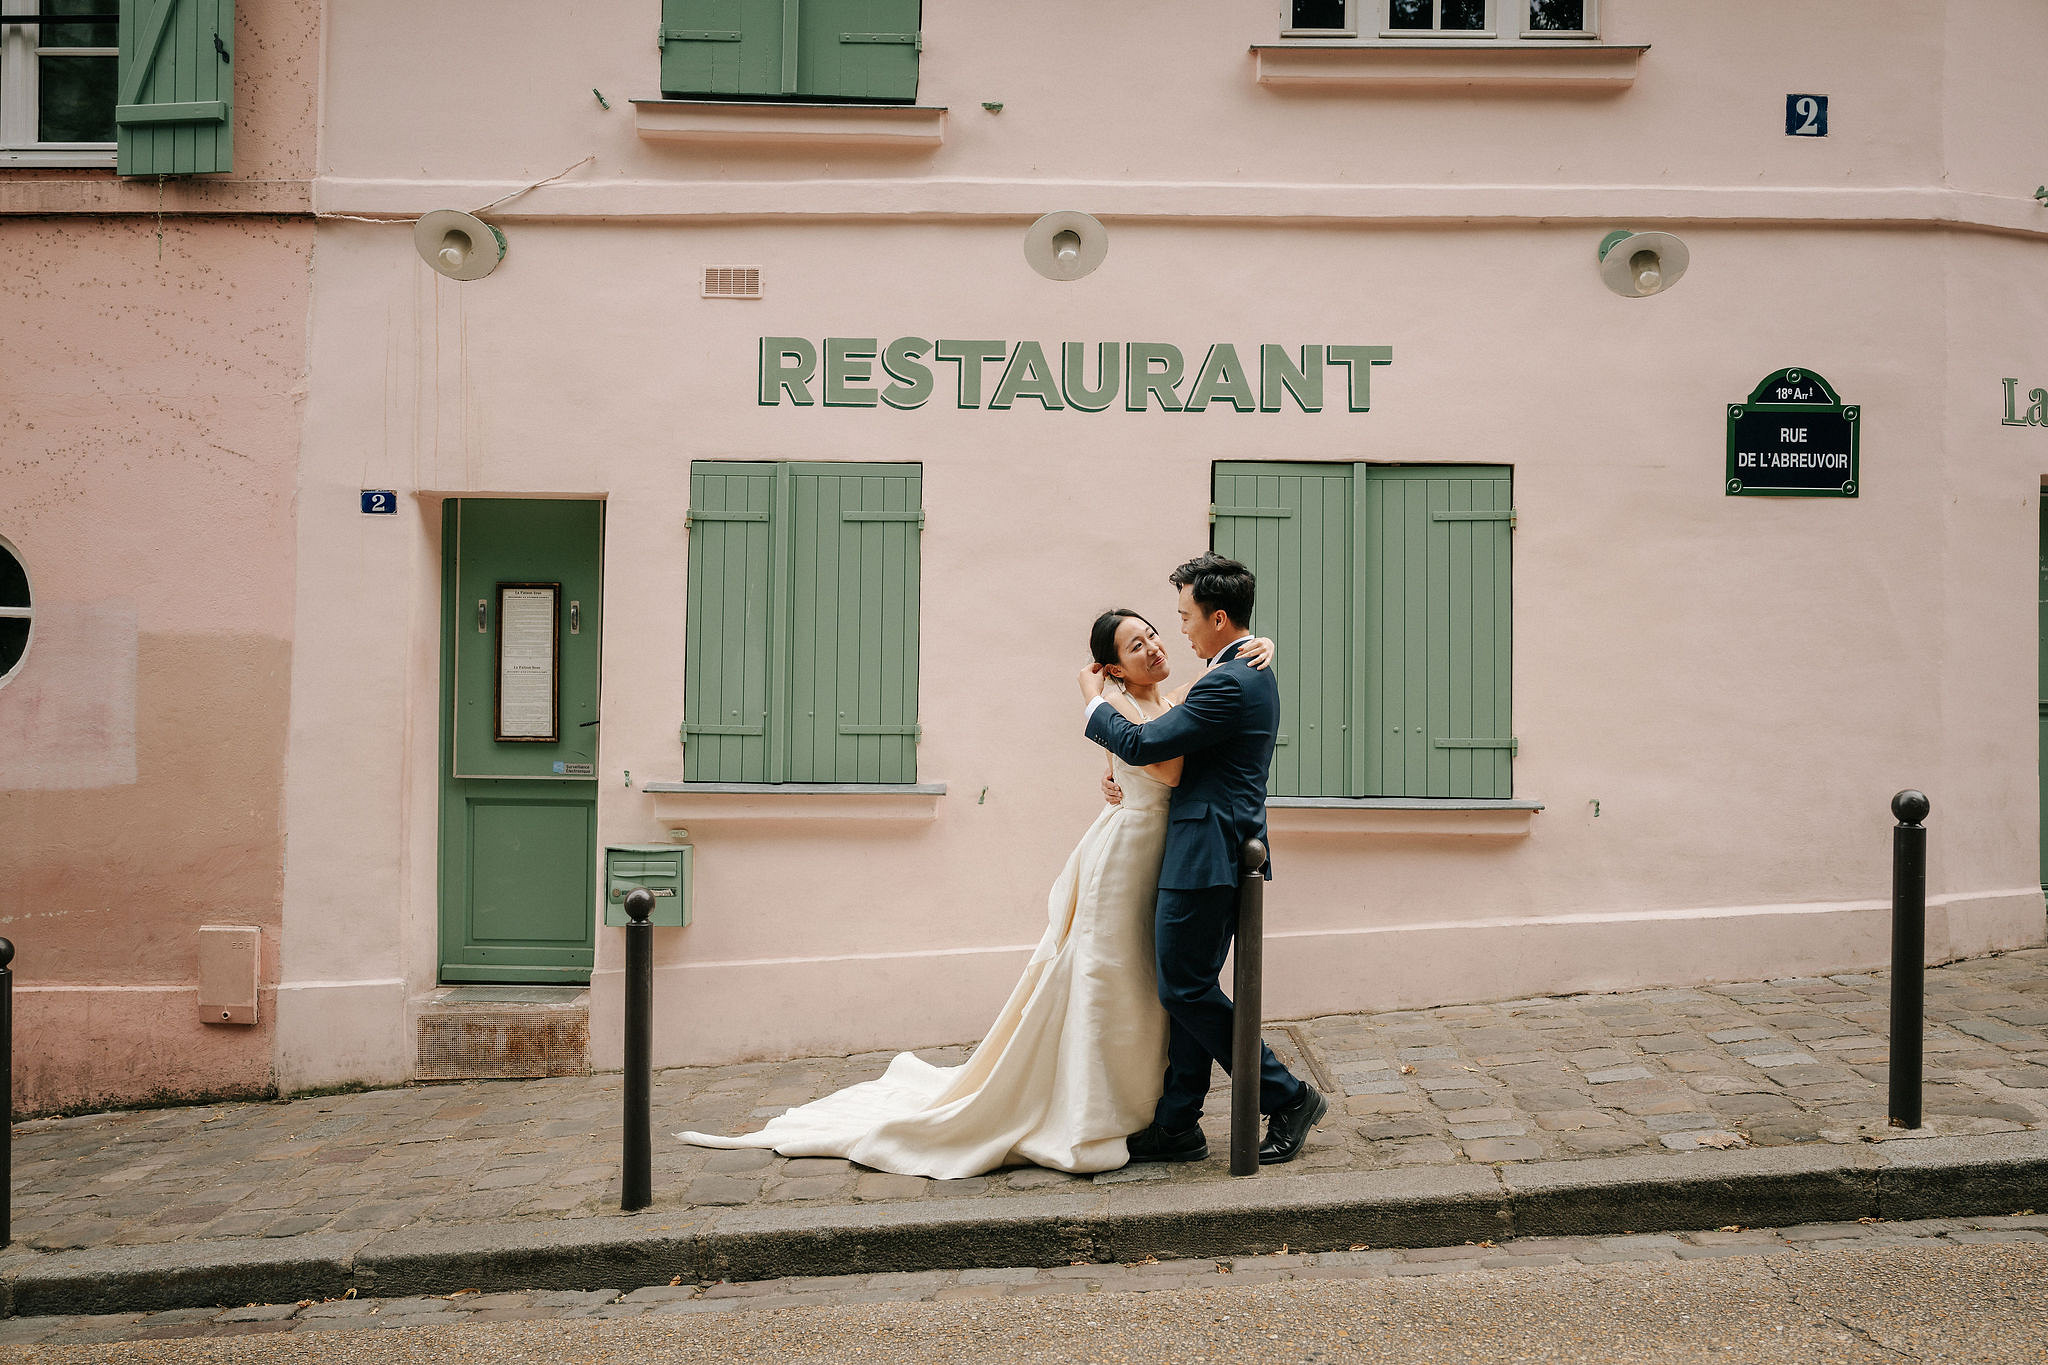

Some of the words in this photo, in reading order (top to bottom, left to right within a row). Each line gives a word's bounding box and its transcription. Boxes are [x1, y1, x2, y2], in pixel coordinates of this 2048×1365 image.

[1796, 97, 1818, 134] 2
[758, 336, 1394, 414] RESTAURANT
[2001, 377, 2048, 428] La
[1780, 427, 1808, 443] RUE
[1738, 452, 1756, 468] DE
[1760, 452, 1848, 469] L'ABREUVOIR
[371, 494, 386, 512] 2
